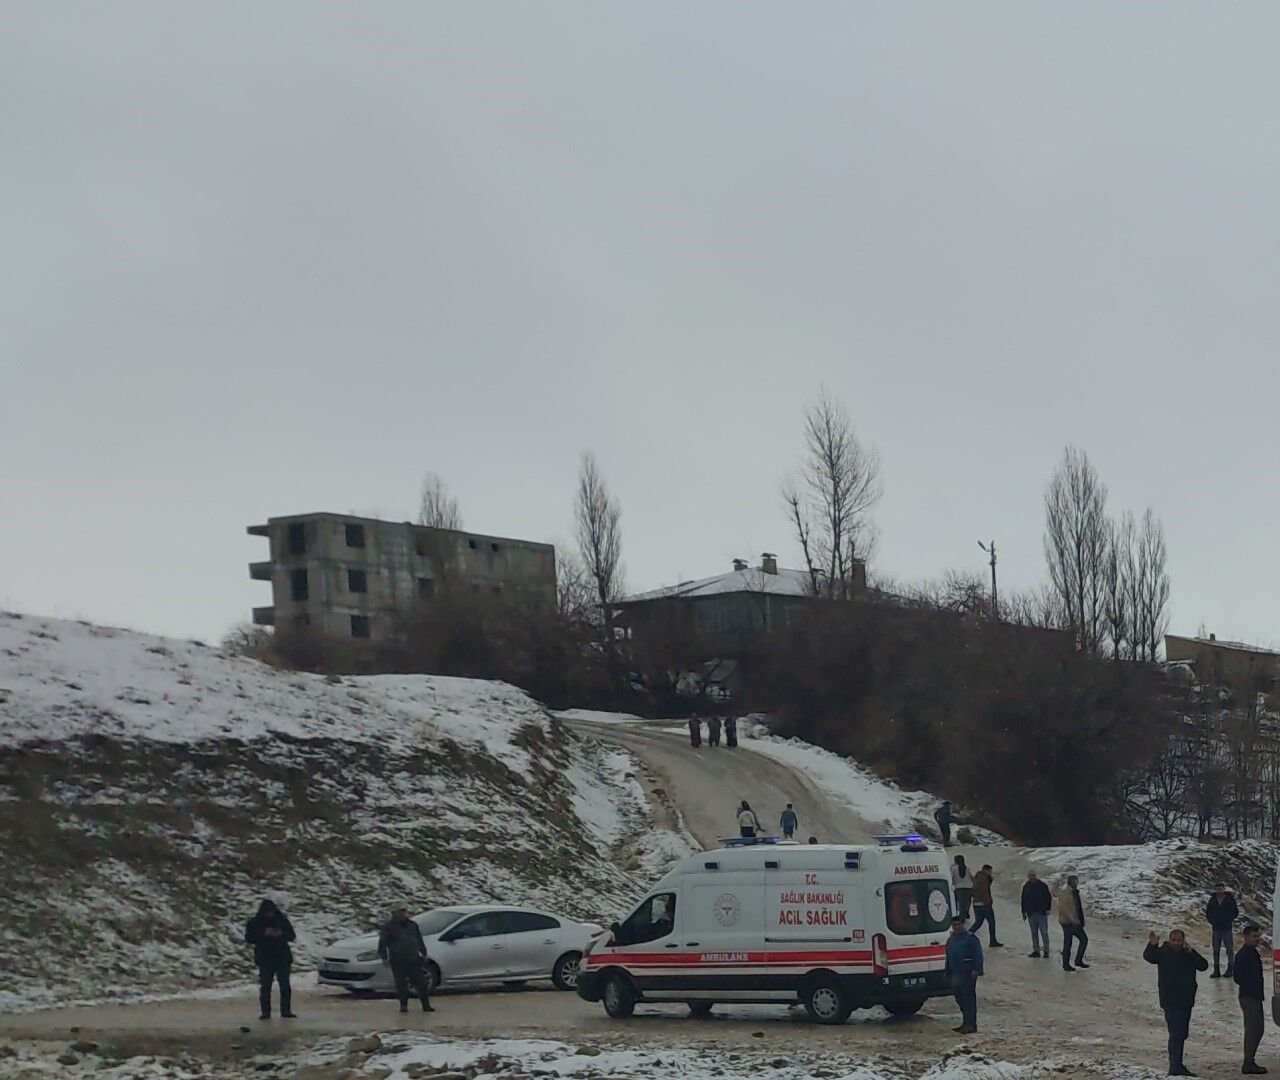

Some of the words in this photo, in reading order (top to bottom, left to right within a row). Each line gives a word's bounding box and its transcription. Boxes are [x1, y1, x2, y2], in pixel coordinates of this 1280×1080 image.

[895, 865, 939, 875] AMBULANS
[805, 874, 819, 886] T.C.
[781, 891, 805, 904] SAĞLIK
[806, 891, 844, 904] BAKANLIĞI
[806, 907, 847, 925] SAĞLIK
[700, 953, 749, 961] AMBULANS
